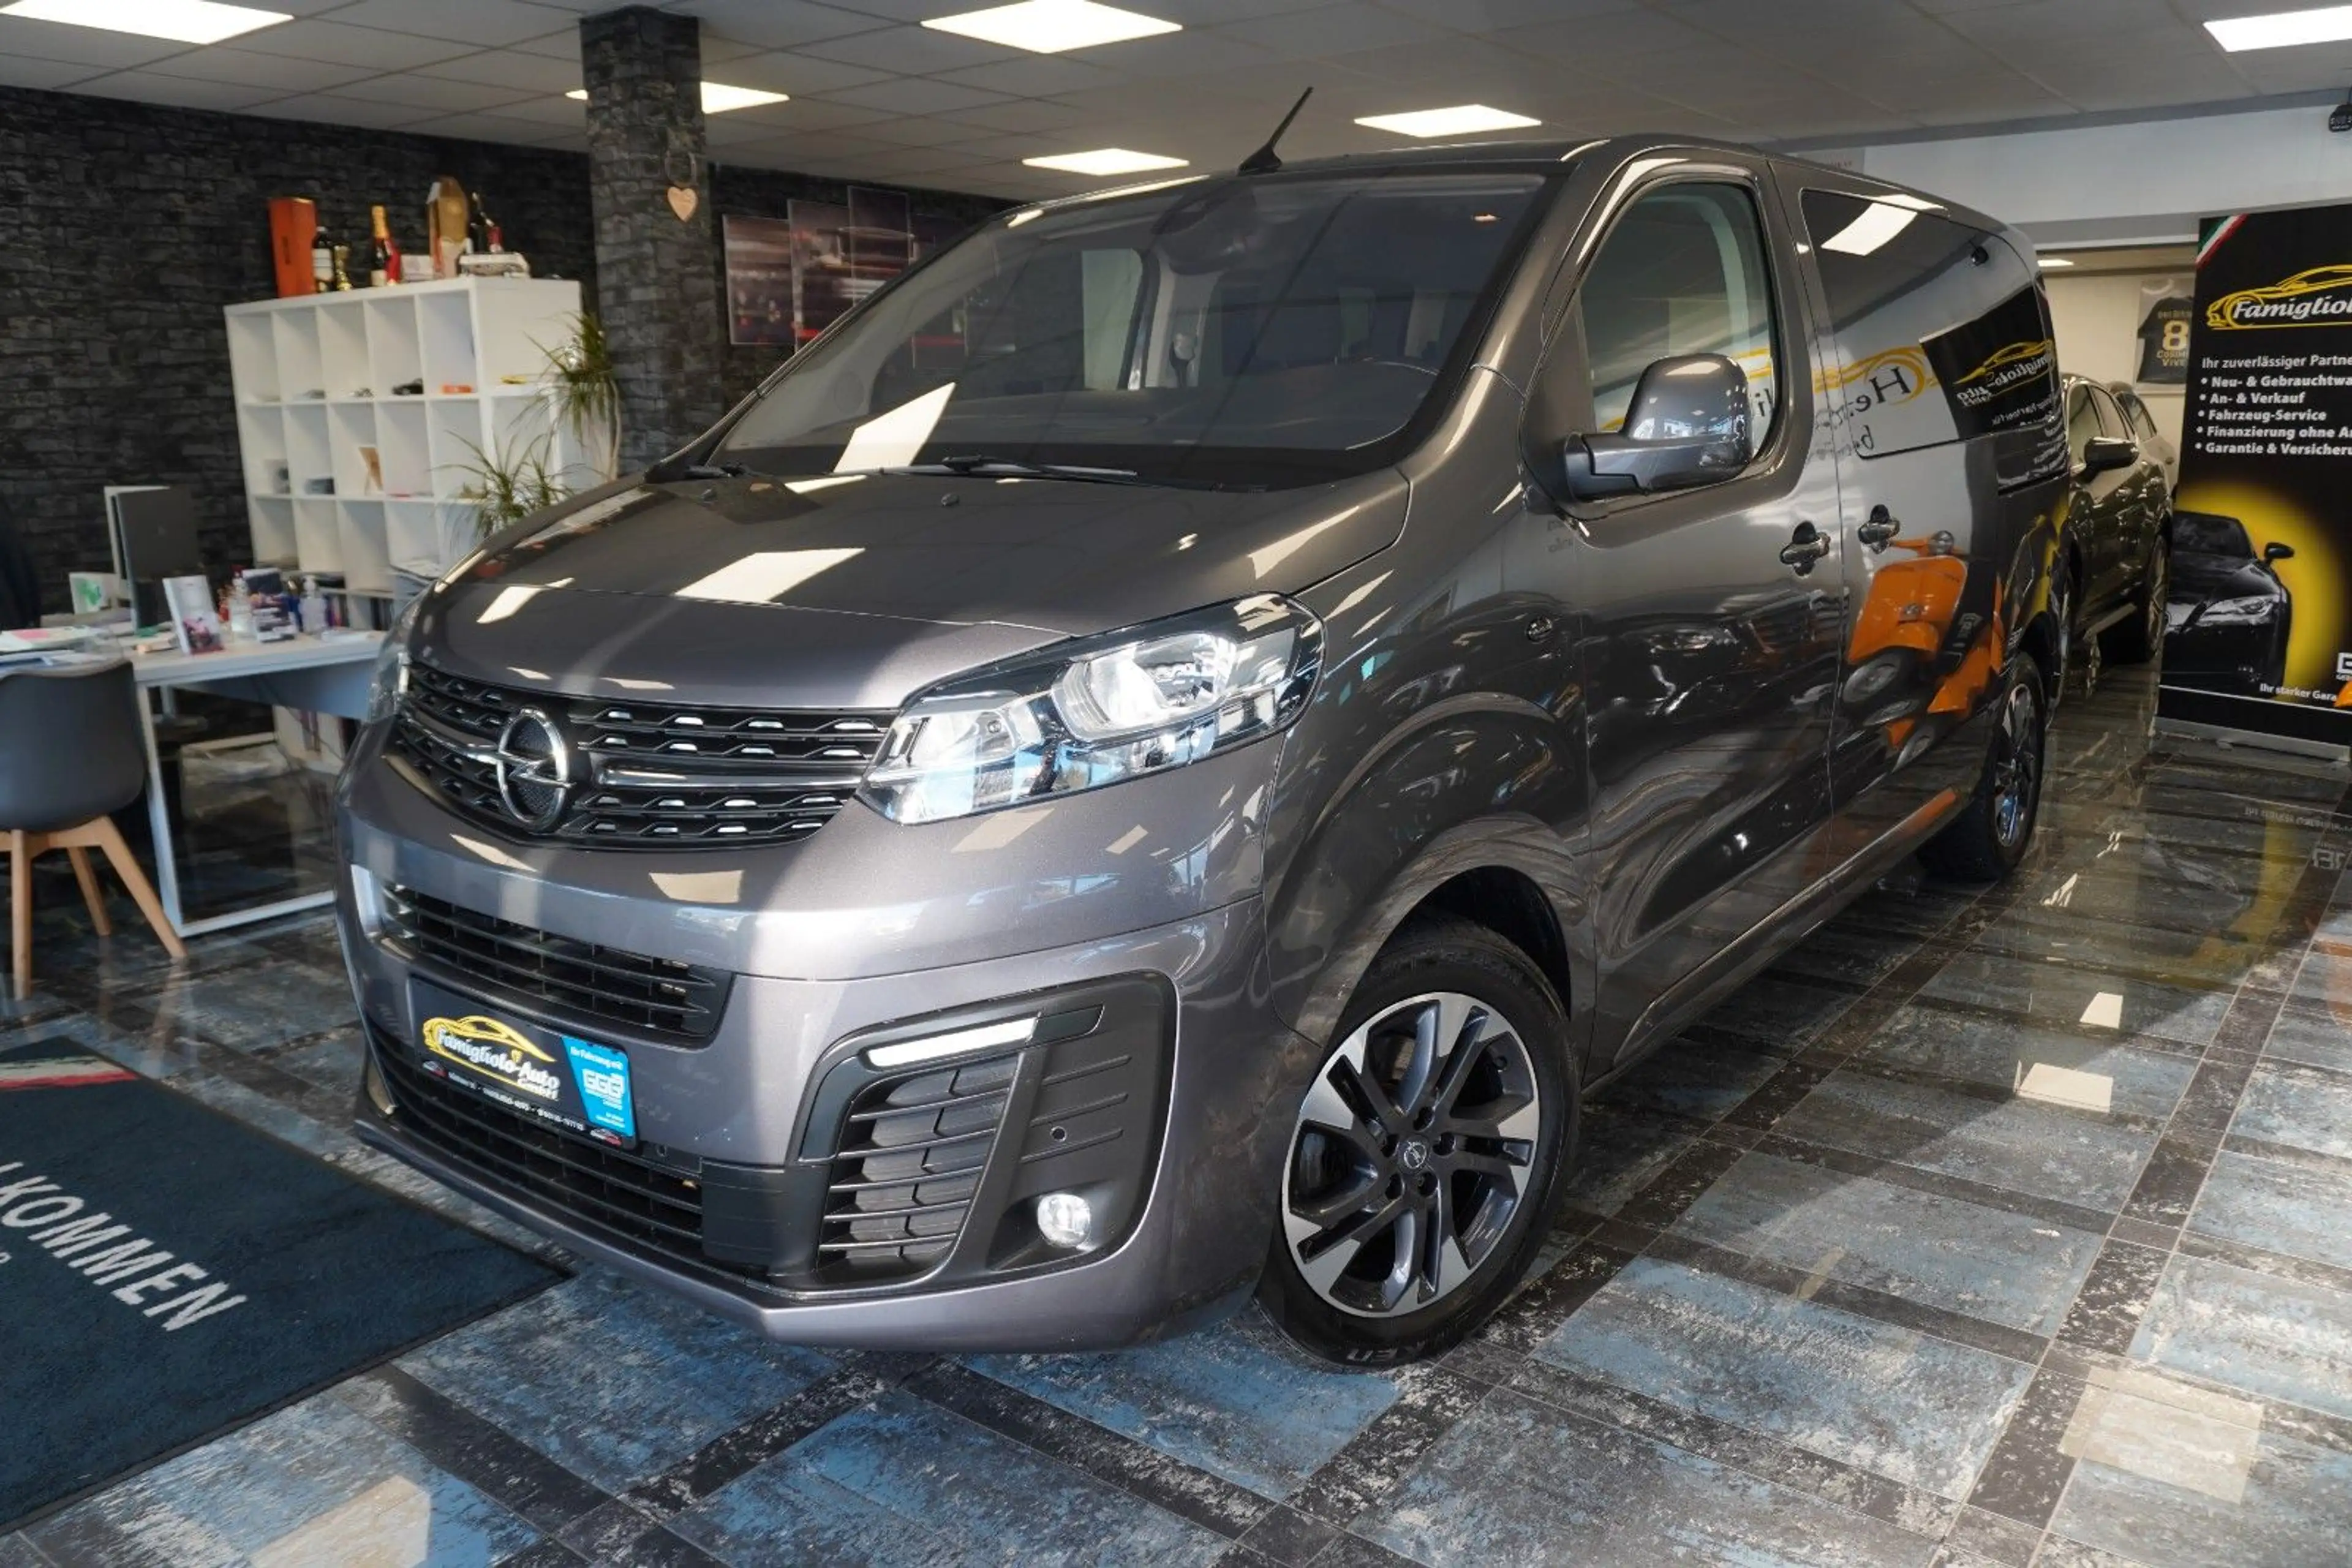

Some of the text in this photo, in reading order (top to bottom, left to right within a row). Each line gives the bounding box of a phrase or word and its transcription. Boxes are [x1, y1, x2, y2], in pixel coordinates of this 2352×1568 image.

[2233, 295, 2352, 320] Famiglio
[2162, 320, 2188, 350] 8
[2202, 357, 2218, 369] Ihr
[2222, 356, 2306, 370] zuverlässiger
[2212, 377, 2242, 388] Neu-
[2246, 376, 2257, 387] &
[2209, 391, 2305, 404] An- & Verkauf
[2208, 409, 2327, 423] Fahrzeug-Service
[2206, 425, 2294, 440] Finanzierung
[2299, 426, 2334, 438] ohne
[2206, 442, 2264, 454] Garantie
[2267, 443, 2277, 454] &
[2260, 683, 2275, 694] Ihr
[2275, 685, 2311, 698] starker
[0, 1162, 247, 1331] KOMMEN
